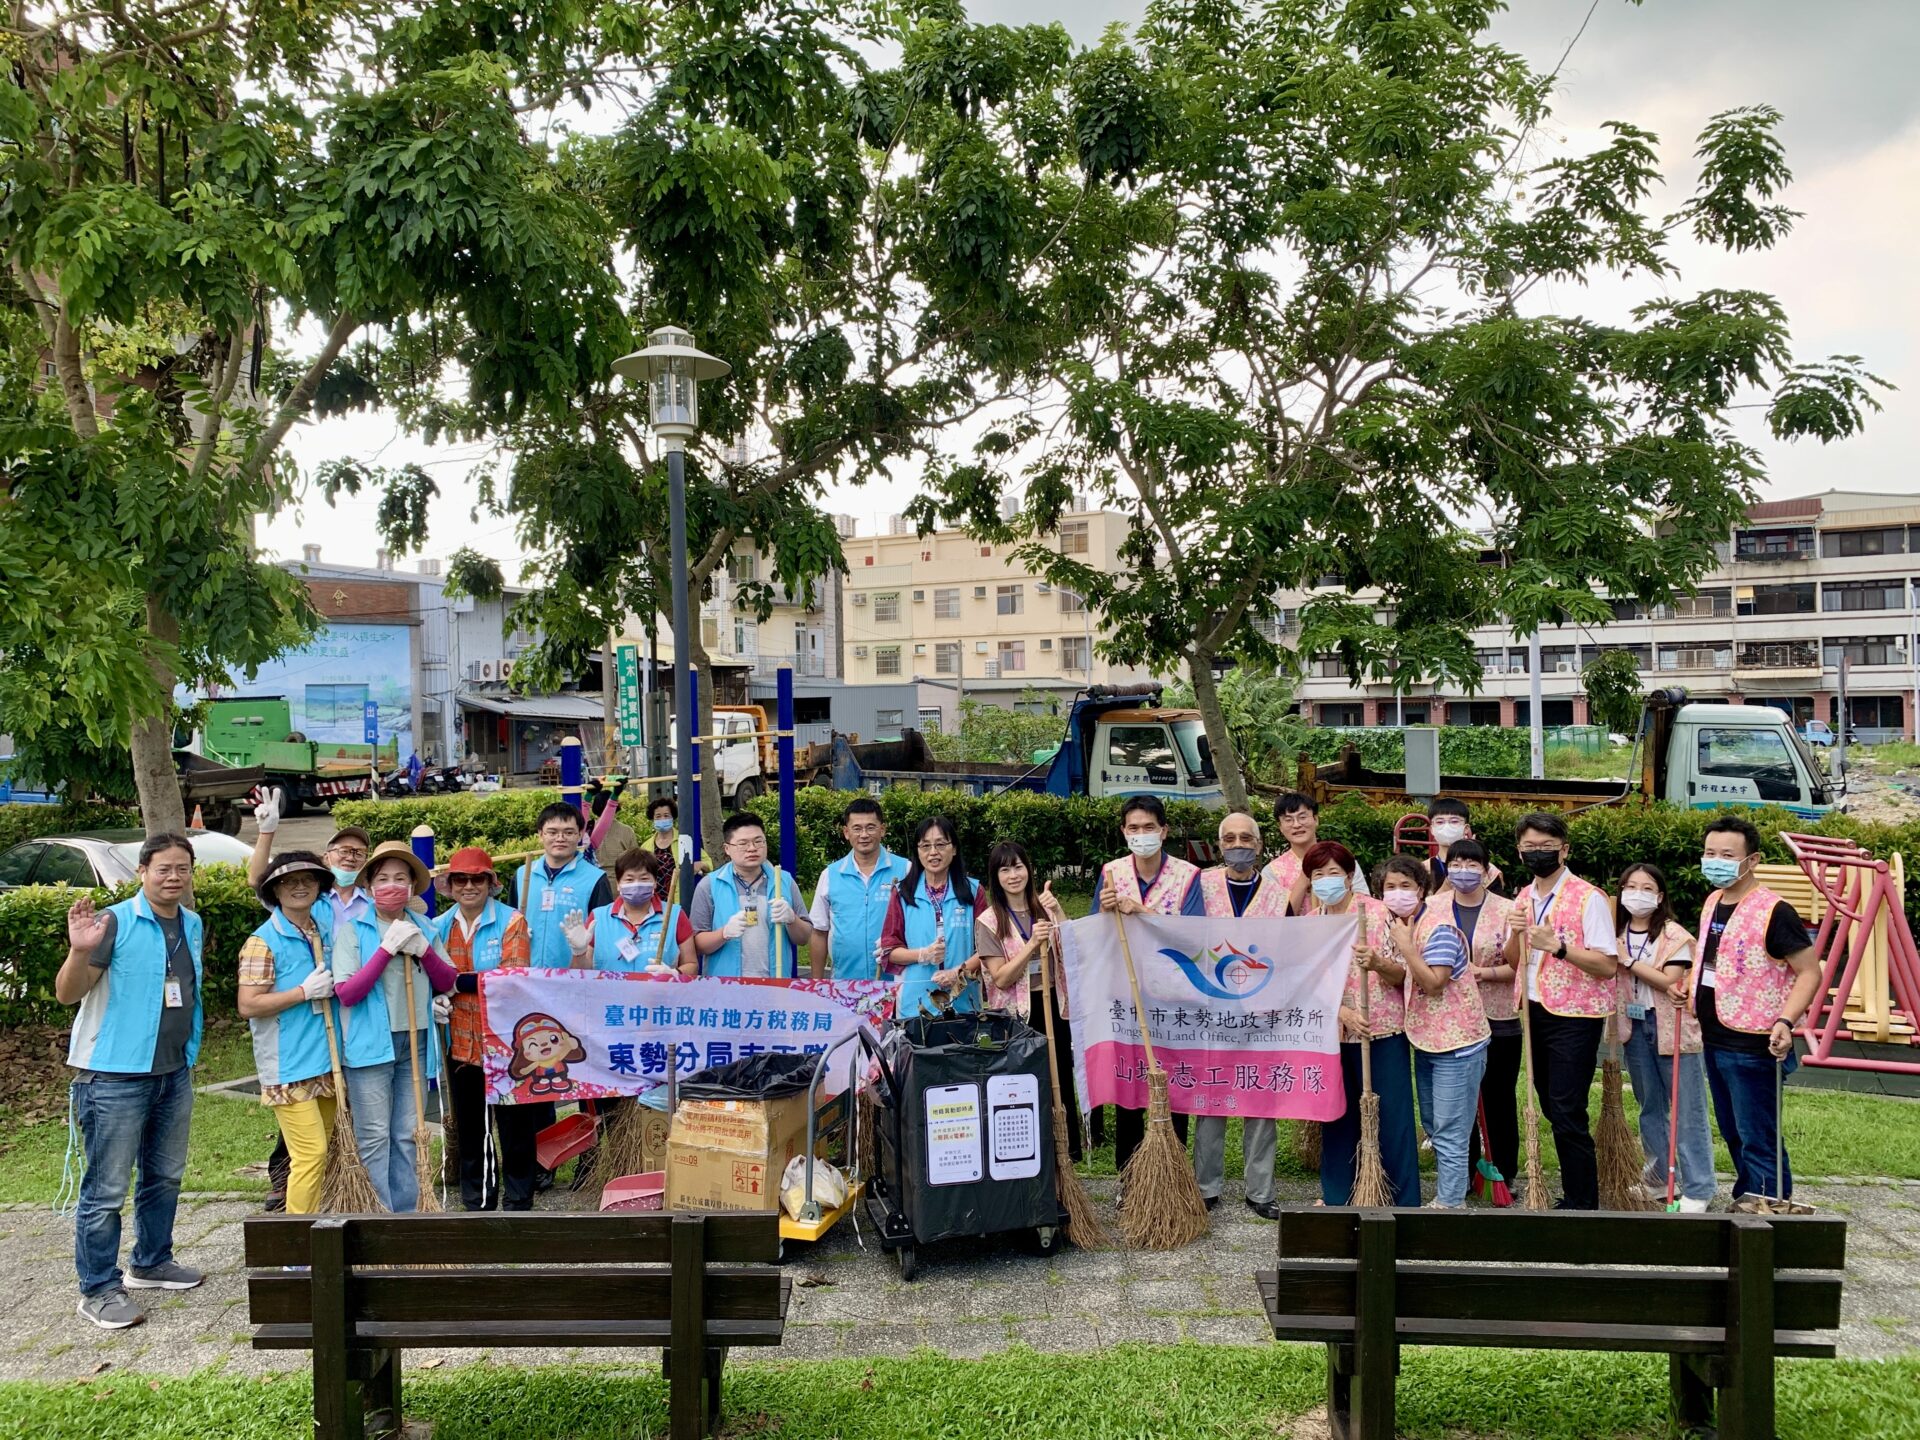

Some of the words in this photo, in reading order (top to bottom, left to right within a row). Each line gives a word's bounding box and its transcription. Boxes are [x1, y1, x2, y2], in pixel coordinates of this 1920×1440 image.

[366, 705, 375, 739] 出口
[604, 1005, 833, 1031] 臺中市政府地方稅務局
[1109, 999, 1324, 1029] 臺中市東勢地政事務所
[1167, 1029, 1196, 1041] Land
[1200, 1031, 1240, 1044] Office,
[1244, 1031, 1300, 1045] Taichung
[1303, 1031, 1324, 1047] City
